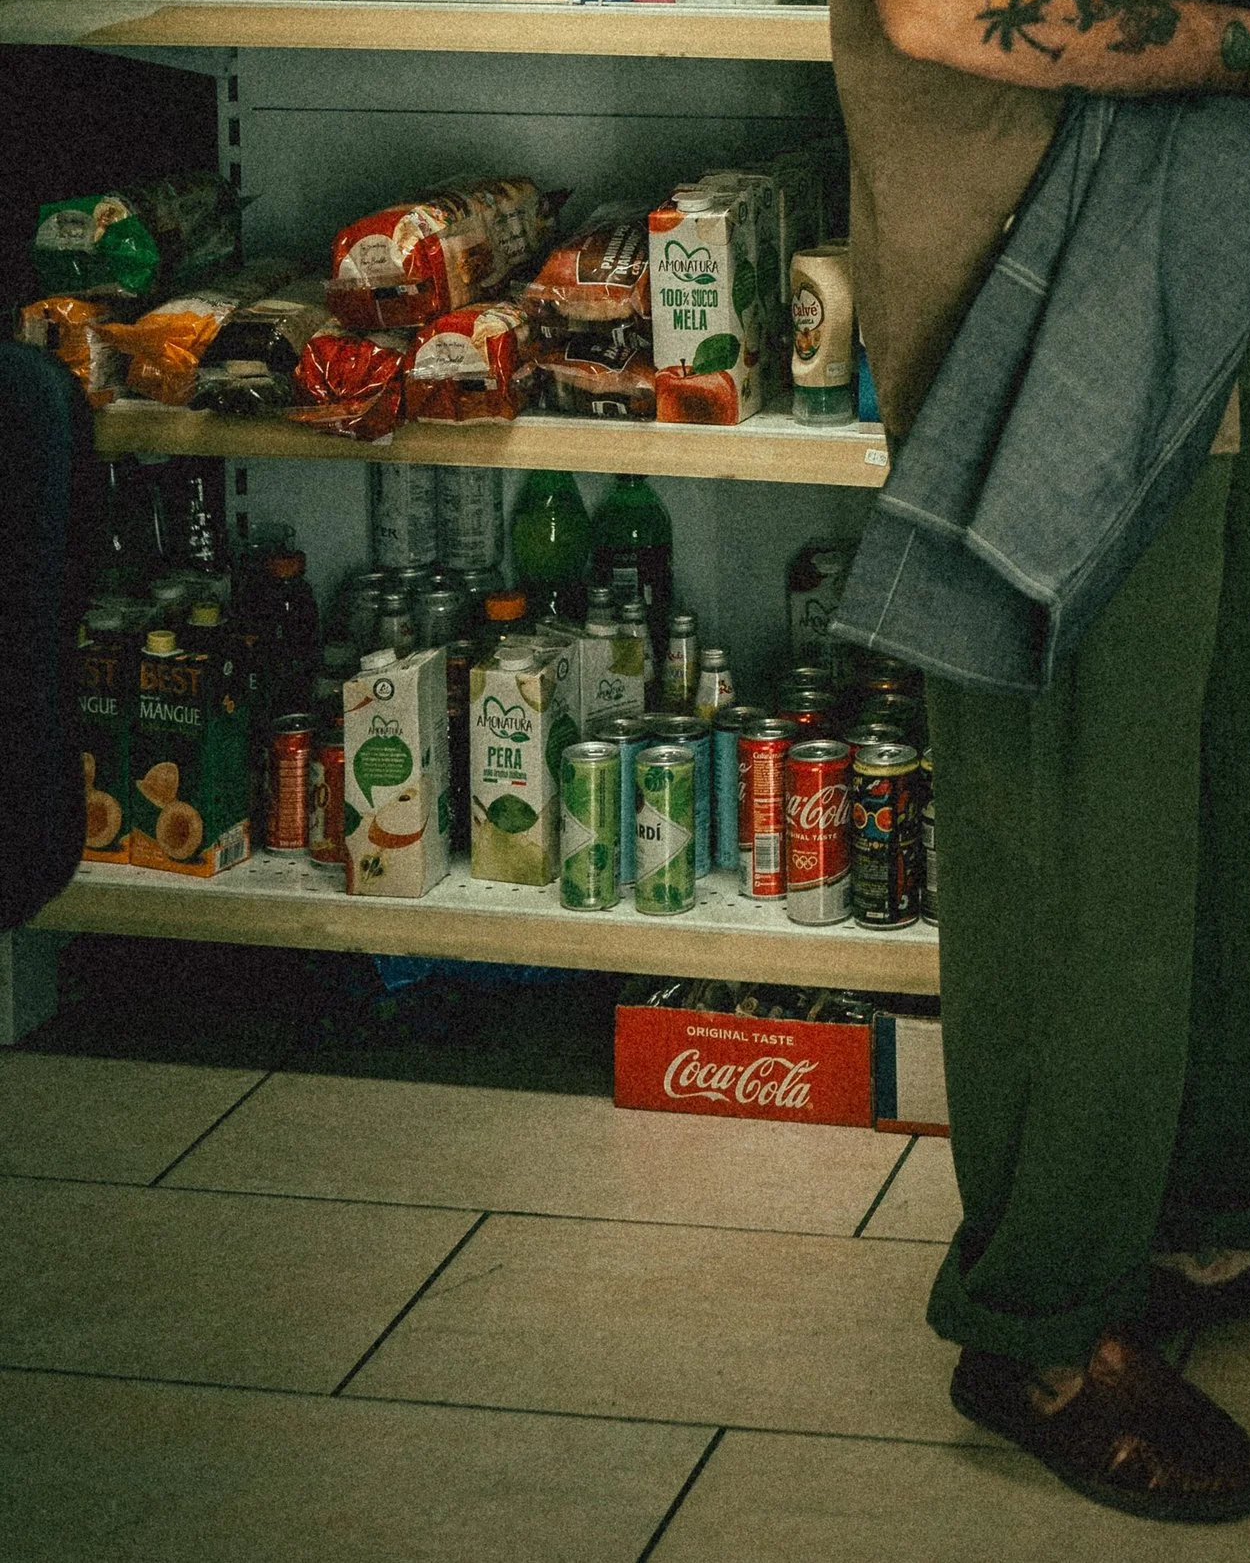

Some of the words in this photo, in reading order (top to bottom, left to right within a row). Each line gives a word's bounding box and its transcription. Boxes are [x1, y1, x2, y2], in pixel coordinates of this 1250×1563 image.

[658, 286, 690, 308] 100%
[691, 287, 720, 309] SUCCO
[792, 300, 819, 318] Calvé
[673, 308, 708, 331] MELA
[139, 658, 200, 696] BEST
[139, 701, 201, 727] MANGUE
[487, 744, 523, 769] PERA
[686, 1025, 749, 1042] ORIGINAL
[752, 1032, 795, 1047] TASTE
[663, 1048, 820, 1109] Coca-Cola
